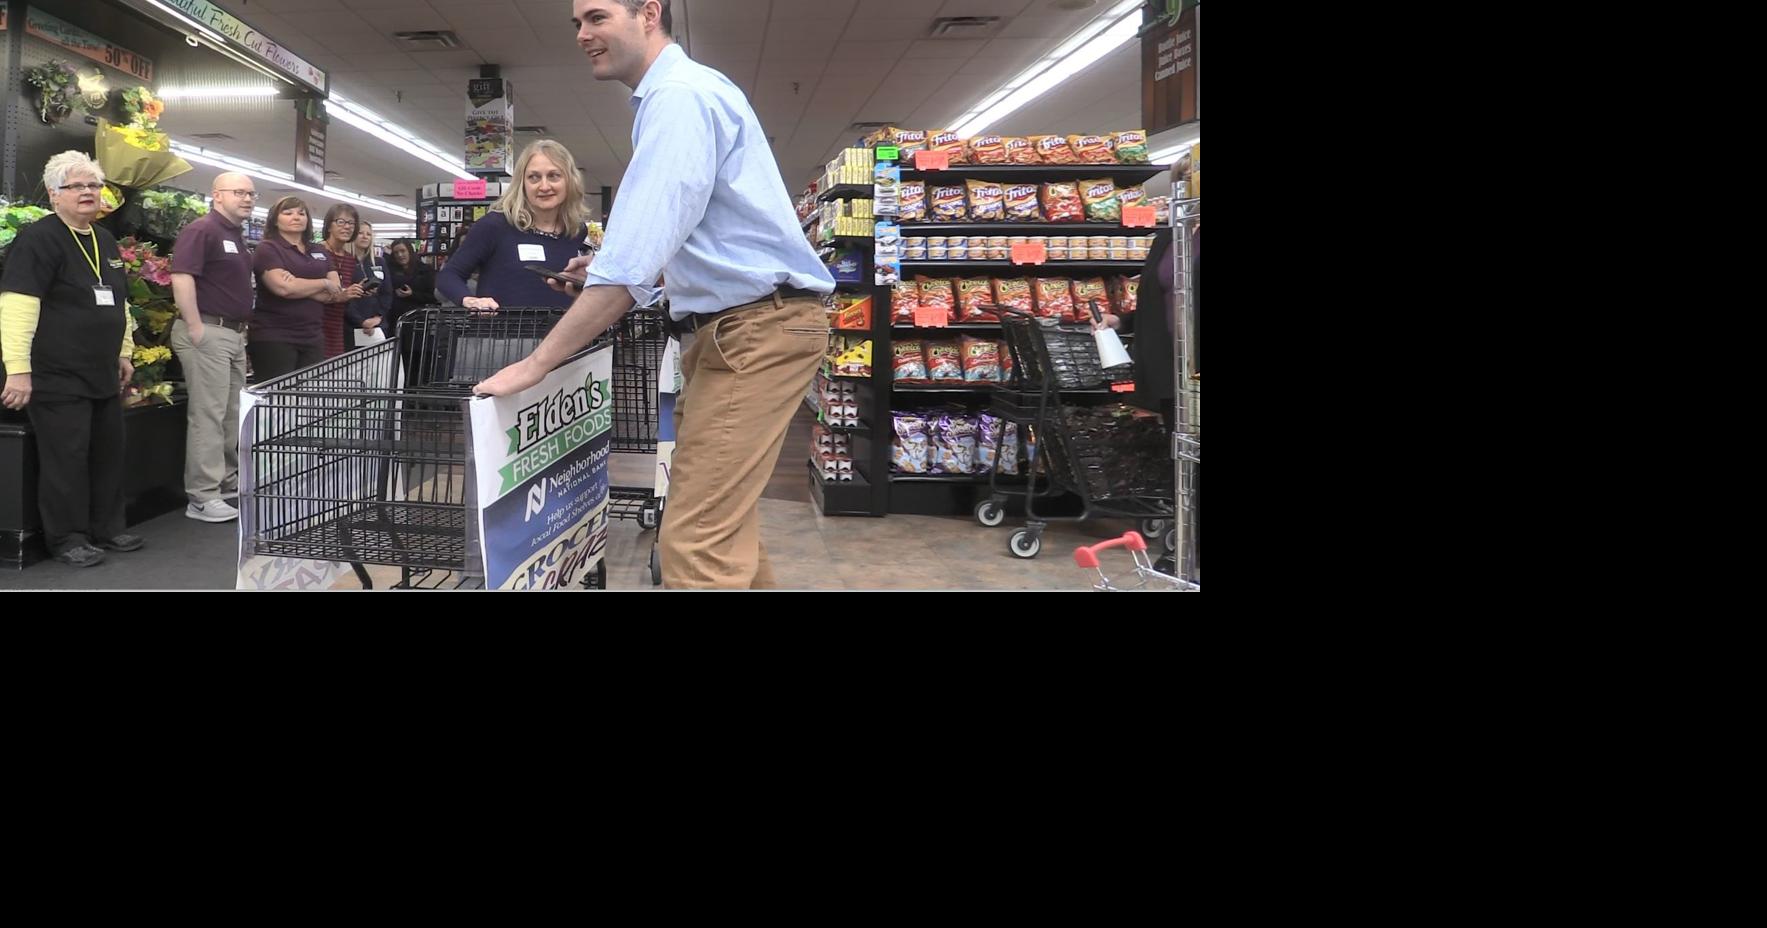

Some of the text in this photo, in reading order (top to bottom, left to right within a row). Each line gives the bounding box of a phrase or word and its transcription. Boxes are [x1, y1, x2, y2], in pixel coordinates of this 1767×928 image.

[131, 55, 150, 79] OFF
[210, 8, 241, 40] Fresh
[244, 31, 262, 52] Cut
[265, 41, 299, 75] Flowers
[515, 371, 604, 454] Elden's
[512, 408, 612, 482] FRESH FOODS
[549, 439, 610, 493] Neighborhood
[557, 471, 591, 498] NATIONAL
[546, 506, 565, 525] Help
[511, 506, 608, 589] GROCE
